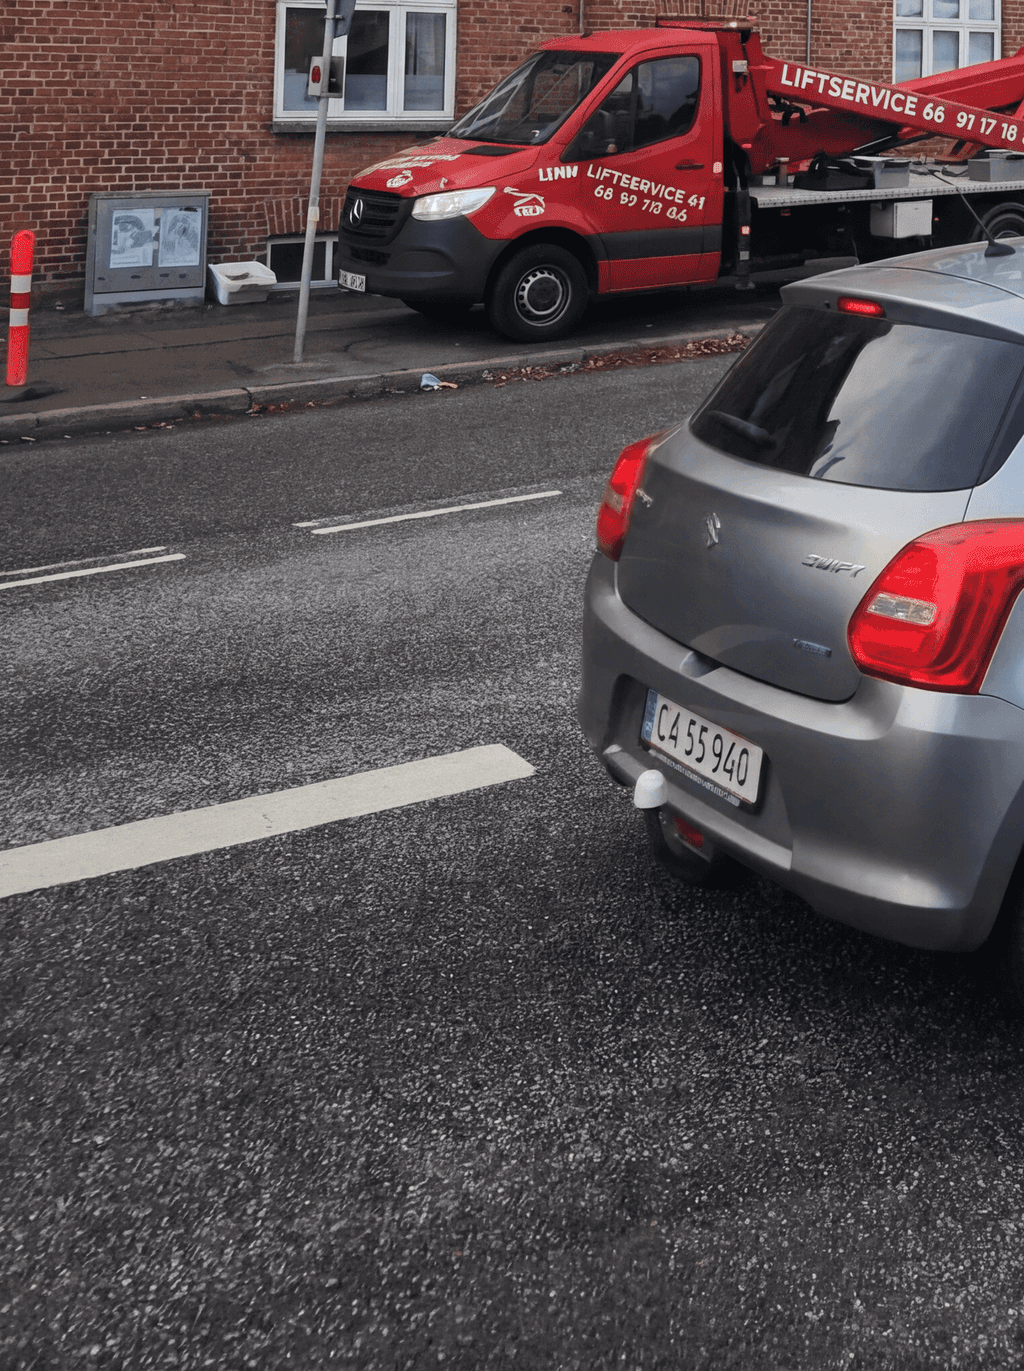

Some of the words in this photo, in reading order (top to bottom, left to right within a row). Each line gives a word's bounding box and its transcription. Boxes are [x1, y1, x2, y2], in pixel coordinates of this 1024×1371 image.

[780, 64, 918, 116] LIFTSERVICE
[922, 103, 946, 124] 66
[956, 111, 976, 131] 91
[979, 117, 997, 136] 17
[1001, 123, 1018, 142] 18
